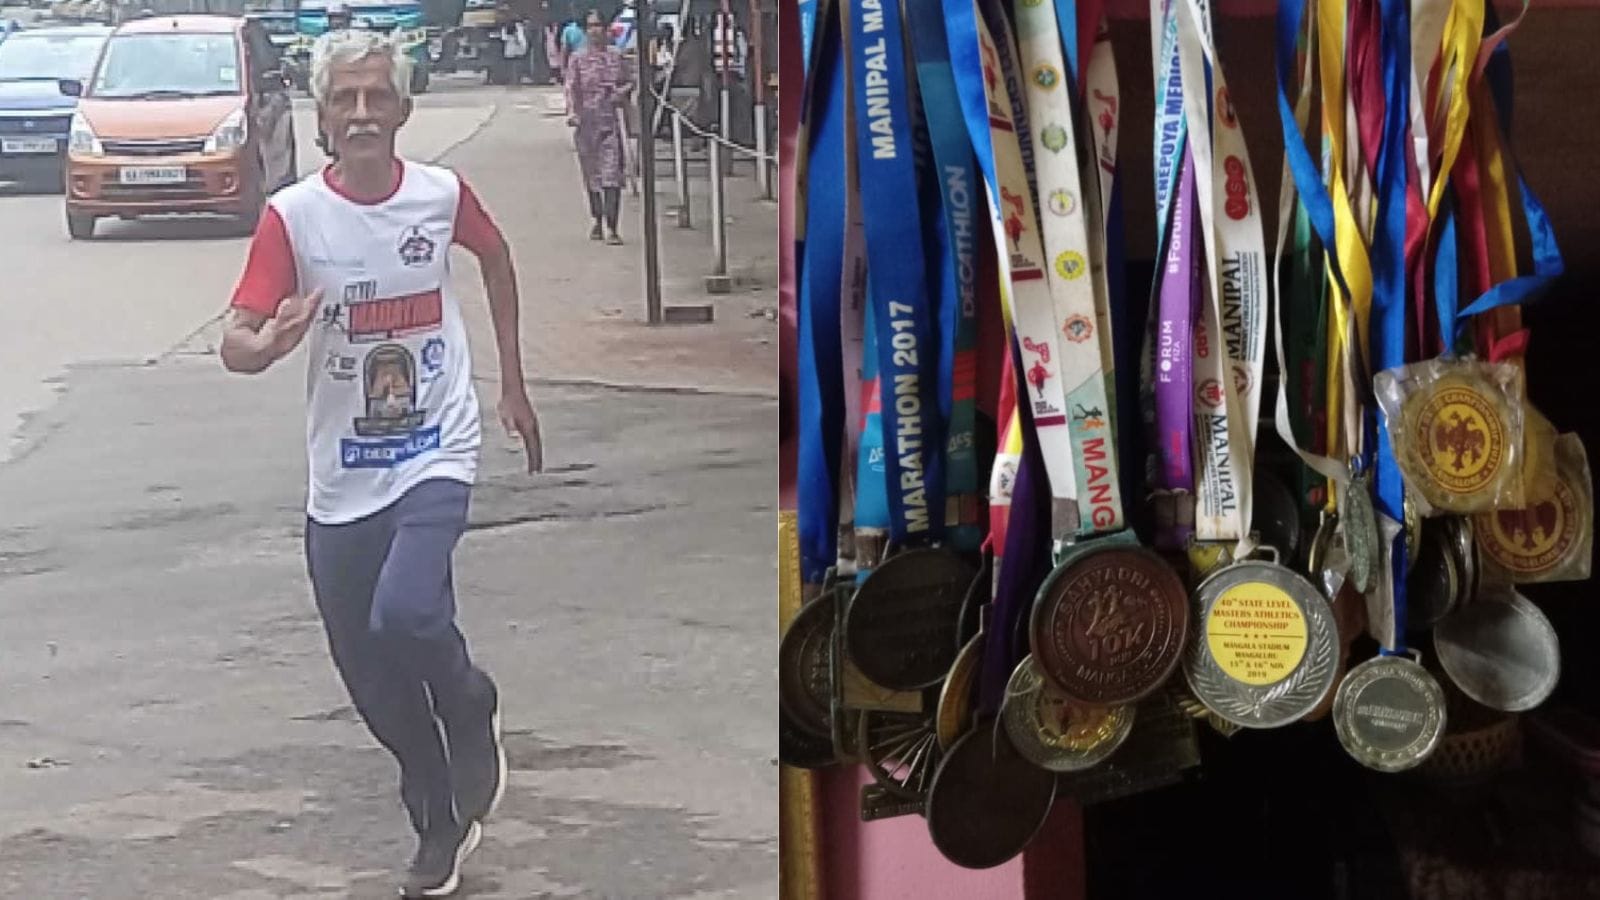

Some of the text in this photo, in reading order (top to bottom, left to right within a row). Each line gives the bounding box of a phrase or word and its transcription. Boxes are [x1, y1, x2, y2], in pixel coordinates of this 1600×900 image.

[864, 37, 897, 160] MANIPAL
[945, 165, 975, 317] DECATHLON
[1222, 251, 1240, 359] MANIPAL
[1160, 320, 1173, 383] FORUM
[1172, 341, 1181, 362] FIZA
[888, 301, 930, 533] MARATHON 2017
[1211, 414, 1236, 517] MANIPAL
[1213, 609, 1300, 619] MASTERS ATHLETICS
[1223, 621, 1289, 630] CHAMPIONSHIP
[1239, 599, 1263, 607] STATE
[1266, 600, 1291, 608] LEVEL
[1223, 642, 1290, 651] MANGALA STADIUM
